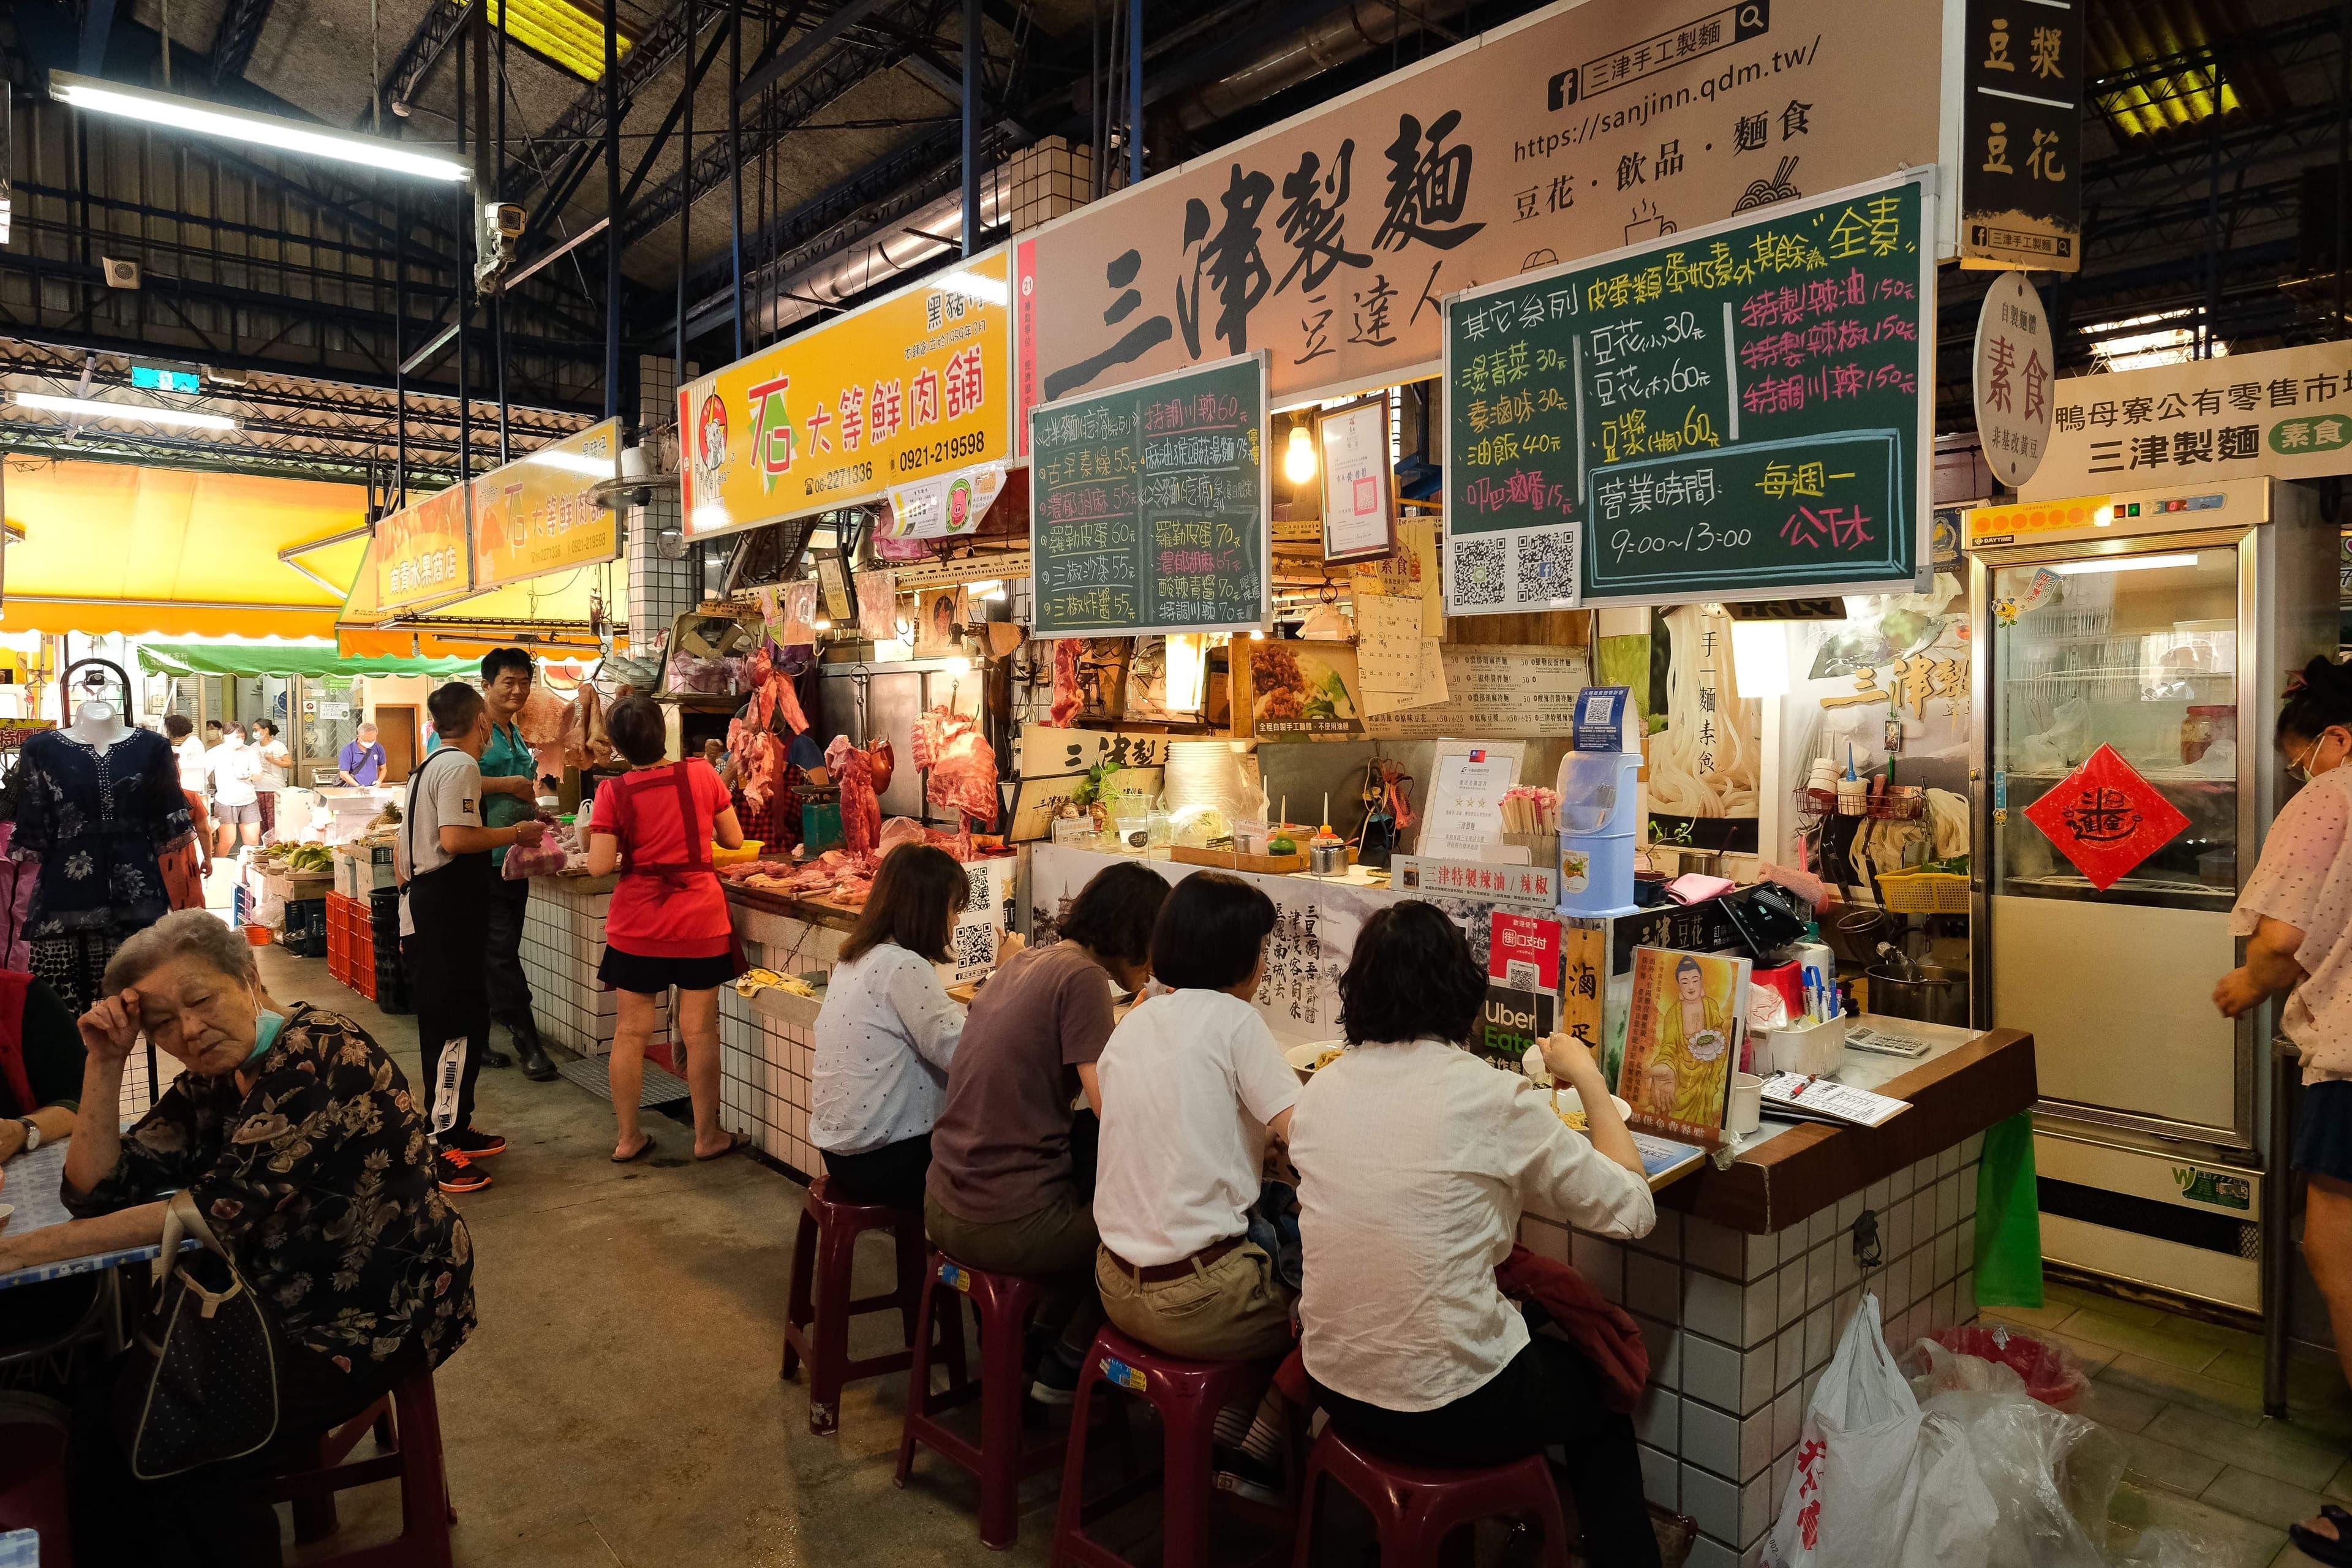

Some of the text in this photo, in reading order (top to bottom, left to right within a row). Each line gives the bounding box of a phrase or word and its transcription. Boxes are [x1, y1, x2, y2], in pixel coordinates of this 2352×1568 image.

[1592, 24, 1721, 89] 三津手工製麵
[1514, 35, 1822, 163] https://sanjinn.qdm.tw/
[1983, 123, 2065, 182] 豆花
[1044, 109, 1487, 398] 三津製麵
[1992, 232, 2051, 252] 三津手工製麵
[1294, 260, 1442, 365] 豆達人
[1462, 283, 1578, 341] 其它系列
[2001, 301, 2038, 336] 自製麵體
[1985, 335, 2049, 426] 素食
[815, 431, 984, 493] 06-2271336 0921-219598
[1992, 426, 2038, 460] 非基改黃豆
[2088, 419, 2343, 474] 三津製麵 素食
[1755, 460, 1856, 500] 每週一
[1065, 733, 1172, 767] 三津製
[1425, 865, 1505, 891] 三津特製辣油
[1520, 873, 1548, 895] 辣椒
[1502, 928, 1547, 950] 街口支付
[1485, 1000, 1536, 1030] Uber
[1485, 1025, 1536, 1054] Eats
[443, 1061, 457, 1088] PUMA
